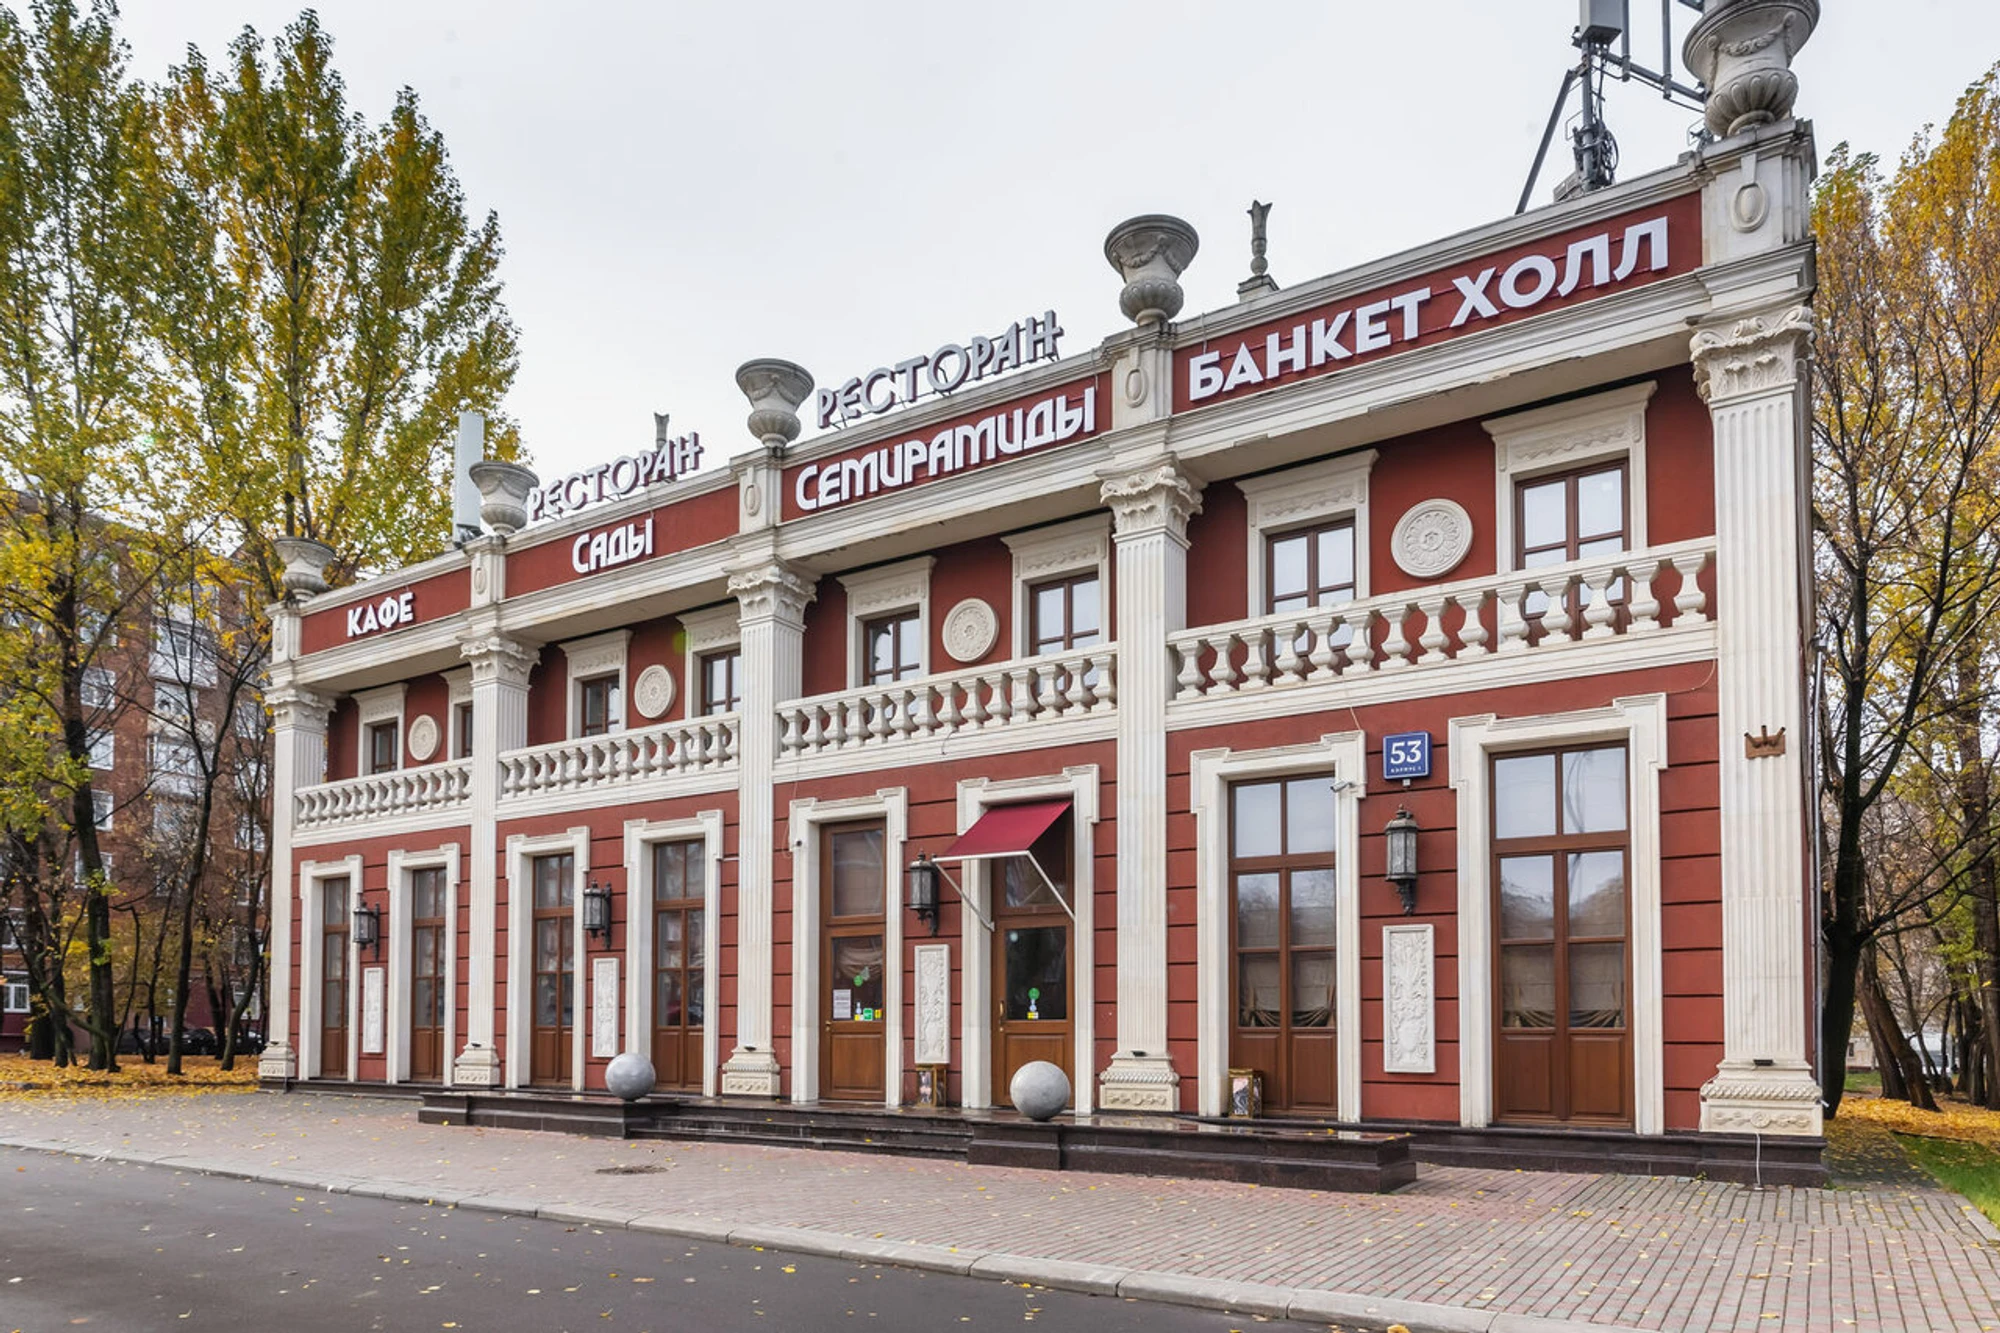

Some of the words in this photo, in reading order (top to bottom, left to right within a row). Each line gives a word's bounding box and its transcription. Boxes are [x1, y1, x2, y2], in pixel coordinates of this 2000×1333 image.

[1189, 287, 1430, 401] БАНКЕТ
[1449, 216, 1669, 328] ХОЛЛ
[817, 310, 1064, 428] РЕСТОРАН
[526, 432, 704, 521] РЕСТОРАН
[795, 386, 1096, 511] СЕМИРАМИДЫ
[572, 518, 654, 574] САДЫ
[347, 592, 414, 638] КАФЕ
[1390, 740, 1422, 765] 53
